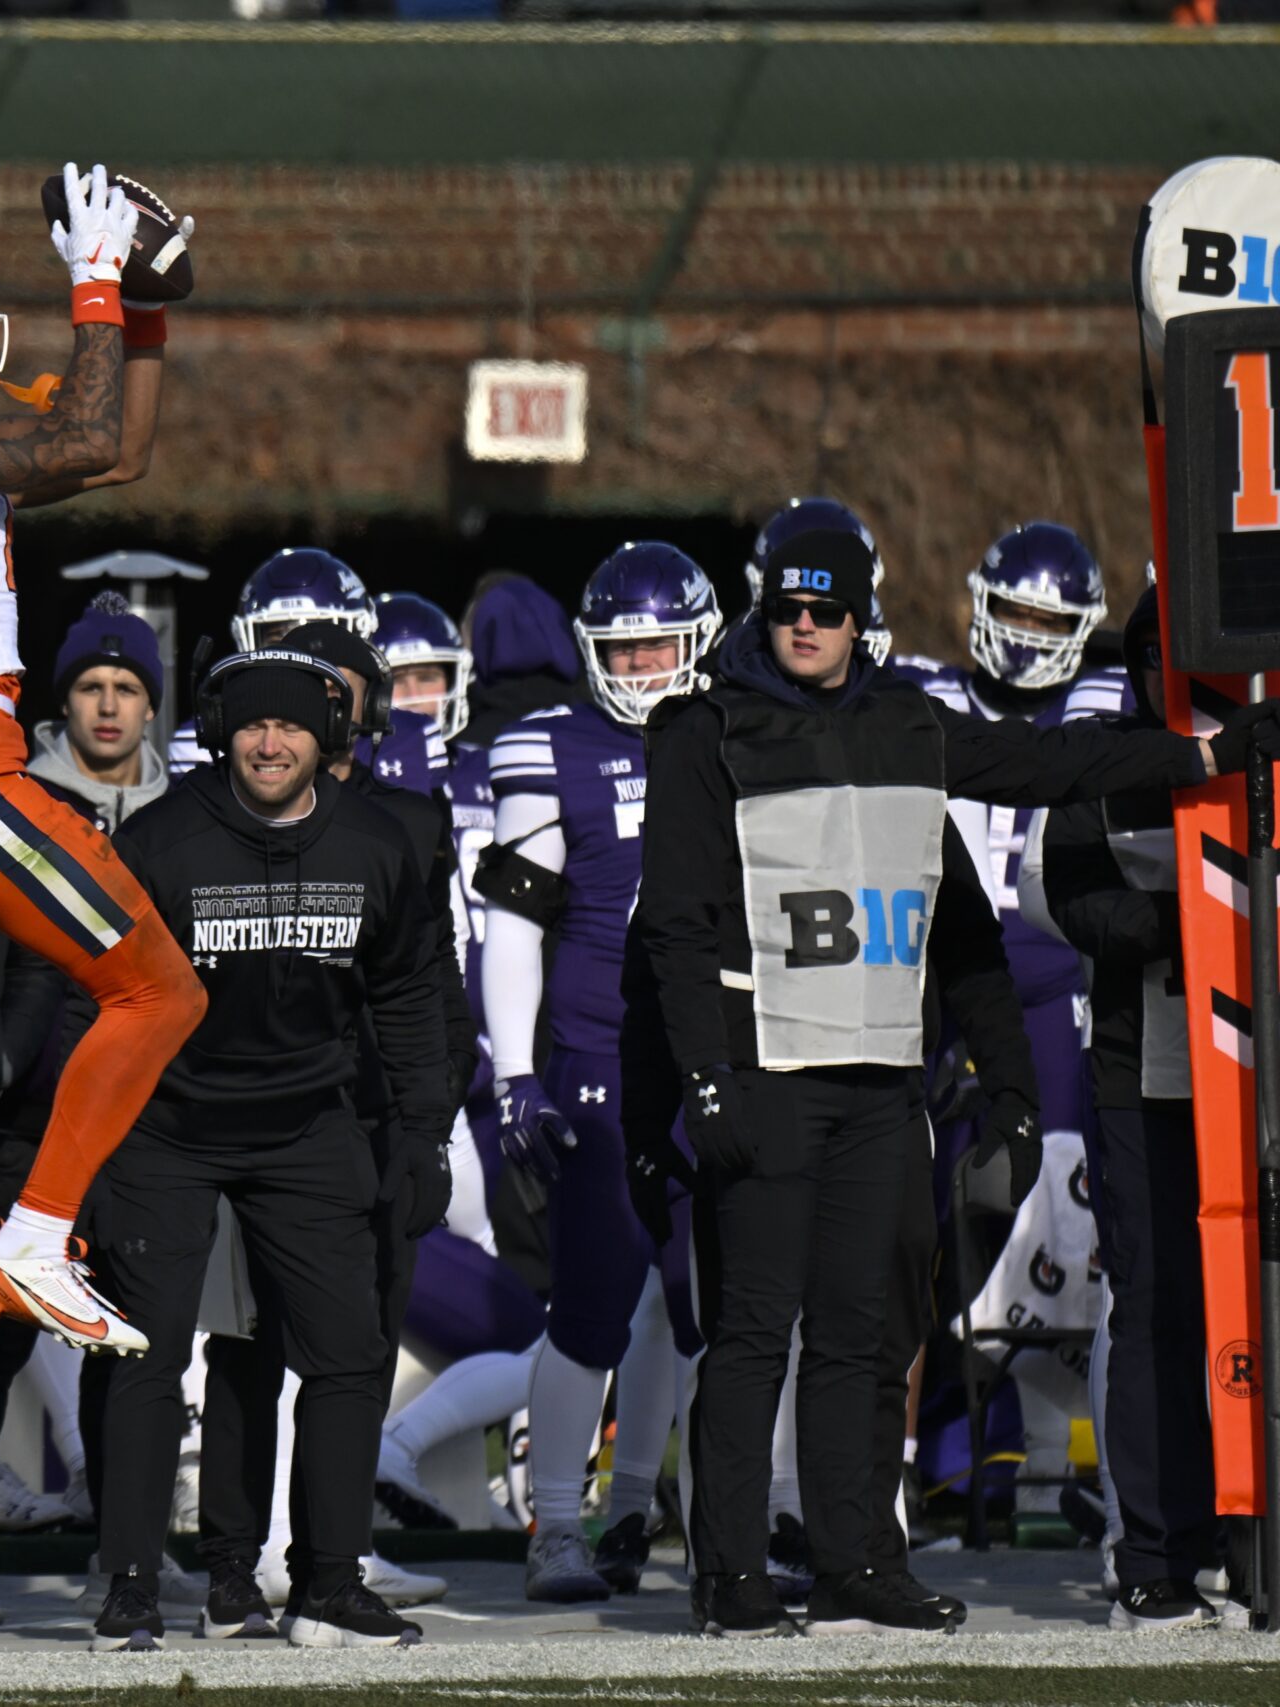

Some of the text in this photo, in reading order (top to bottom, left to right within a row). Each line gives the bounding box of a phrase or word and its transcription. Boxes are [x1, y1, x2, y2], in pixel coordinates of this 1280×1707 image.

[1178, 227, 1280, 305] B1
[1224, 352, 1278, 533] 1
[249, 650, 313, 665] WILDCATS
[192, 915, 363, 952] NORTHWESTERN
[1231, 1354, 1253, 1383] R
